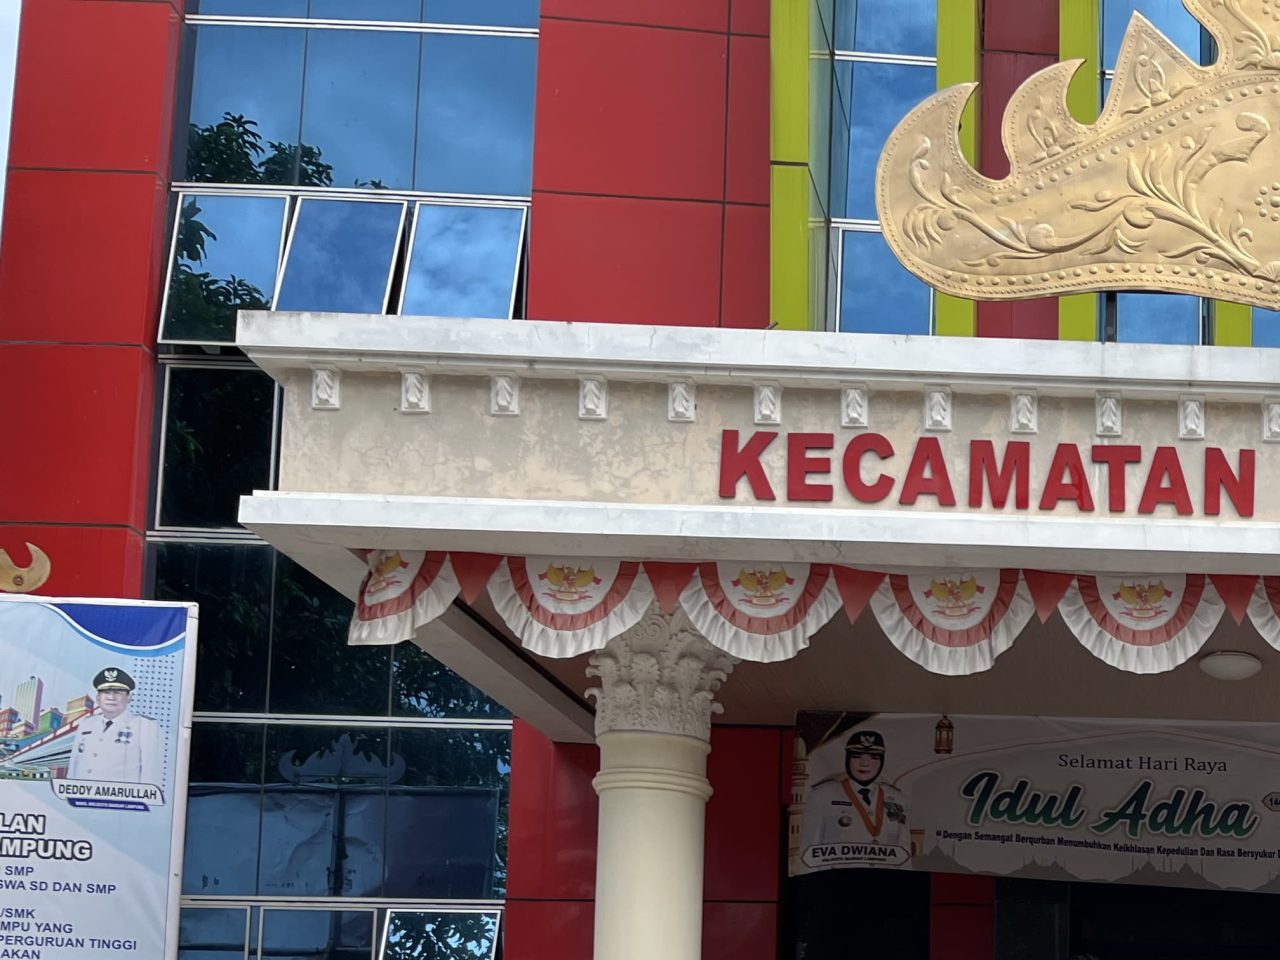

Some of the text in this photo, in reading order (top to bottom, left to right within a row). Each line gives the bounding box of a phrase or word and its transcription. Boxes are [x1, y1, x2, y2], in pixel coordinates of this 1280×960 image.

[718, 429, 1256, 517] KECAMATAN
[1058, 754, 1228, 774] Selamat Hari Raya
[58, 784, 157, 800] DEDDY AMARULLAH
[961, 771, 1260, 839] Idul Adha
[0, 812, 46, 835] LAN
[812, 845, 897, 858] EVA DWIANA
[974, 831, 1013, 844] Semangat
[1057, 837, 1111, 850] Menumbuhkan
[1113, 843, 1154, 854] Keikhlasan
[1157, 845, 1198, 857] Kepedulian
[1200, 847, 1215, 857] Dan
[1217, 848, 1235, 857] Rasa
[1237, 848, 1275, 860] Bersyukur
[5, 865, 34, 876] SMP
[29, 881, 48, 891] SD
[53, 881, 82, 892] DAN
[86, 883, 117, 894] SMP
[0, 921, 73, 933] MPU YANG
[89, 938, 137, 950] TINGGI
[1, 949, 40, 960] AKAN
